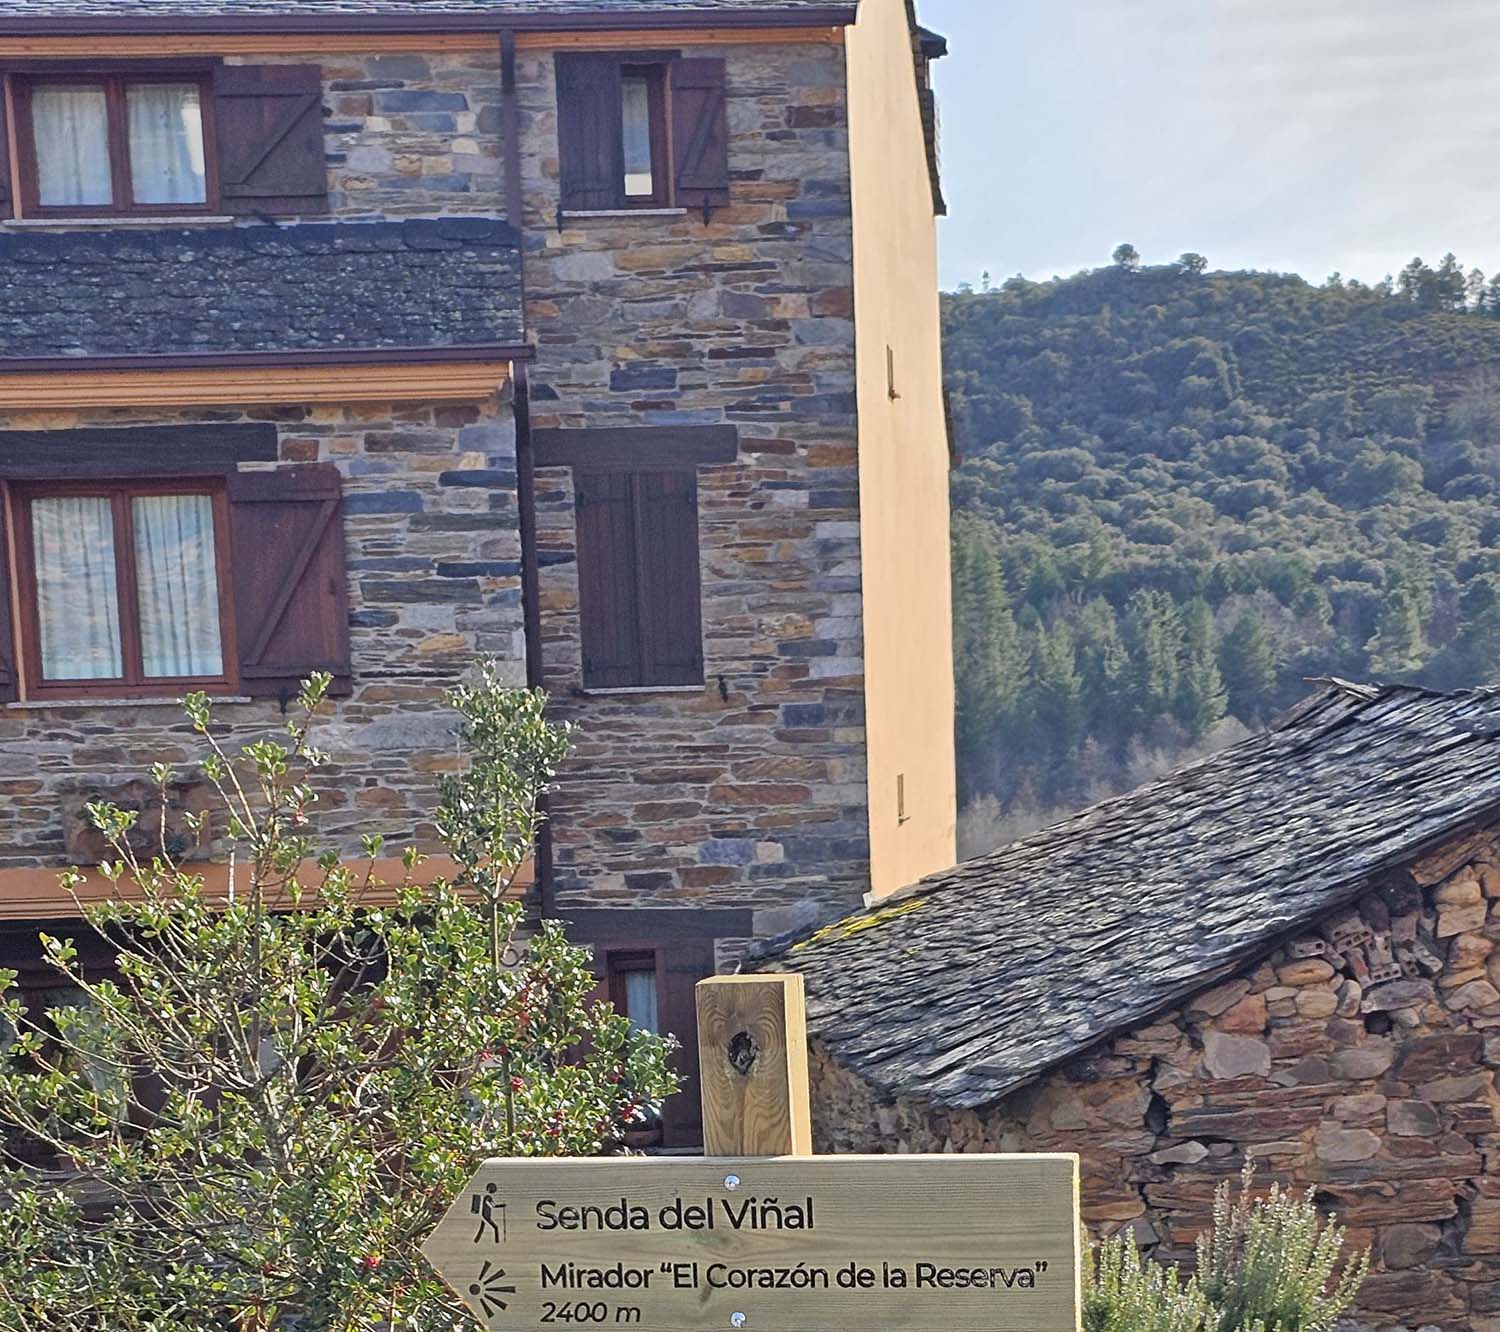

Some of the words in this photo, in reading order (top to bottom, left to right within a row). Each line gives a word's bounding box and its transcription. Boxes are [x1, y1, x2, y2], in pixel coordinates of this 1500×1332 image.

[536, 1197, 649, 1230] Senda
[658, 1197, 714, 1230] del
[720, 1196, 814, 1230] Viñal
[541, 1262, 654, 1289] Mirador
[660, 1262, 698, 1289] “El
[706, 1261, 829, 1289] Corazón
[836, 1262, 876, 1289] de
[882, 1262, 907, 1288] la
[915, 1260, 1048, 1289] Reserva”
[540, 1302, 608, 1323] 2400
[615, 1306, 641, 1323] m
